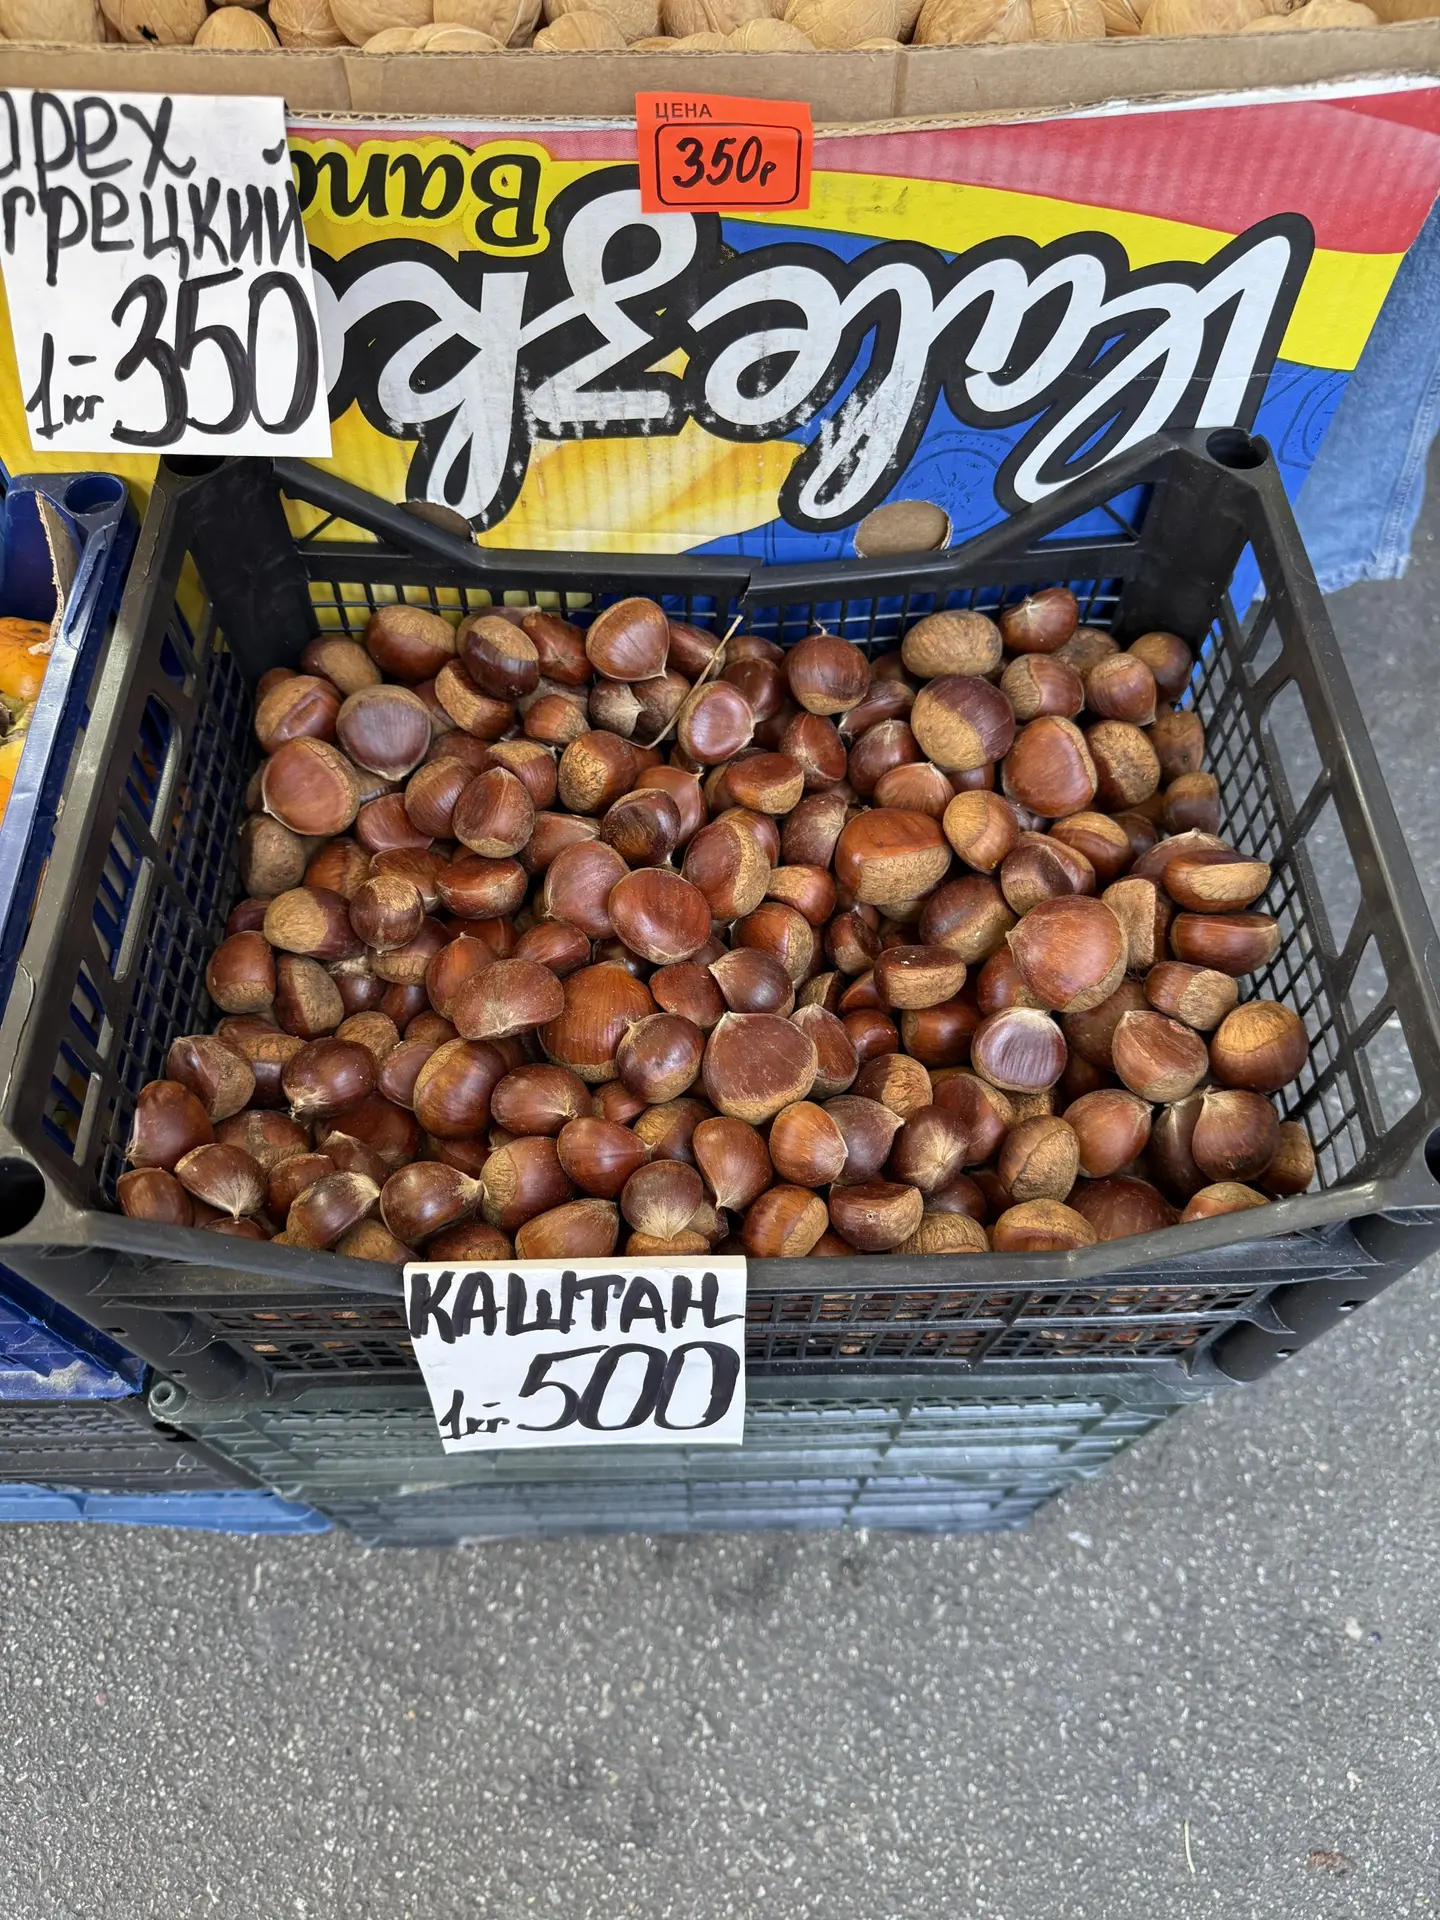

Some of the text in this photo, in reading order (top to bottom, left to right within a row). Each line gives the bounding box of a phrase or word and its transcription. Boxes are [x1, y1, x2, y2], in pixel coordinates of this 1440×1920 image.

[655, 102, 713, 122] ЦЕНА
[110, 267, 319, 448] 350
[408, 1270, 745, 1344] КАШТАН
[517, 1340, 741, 1431] 500
